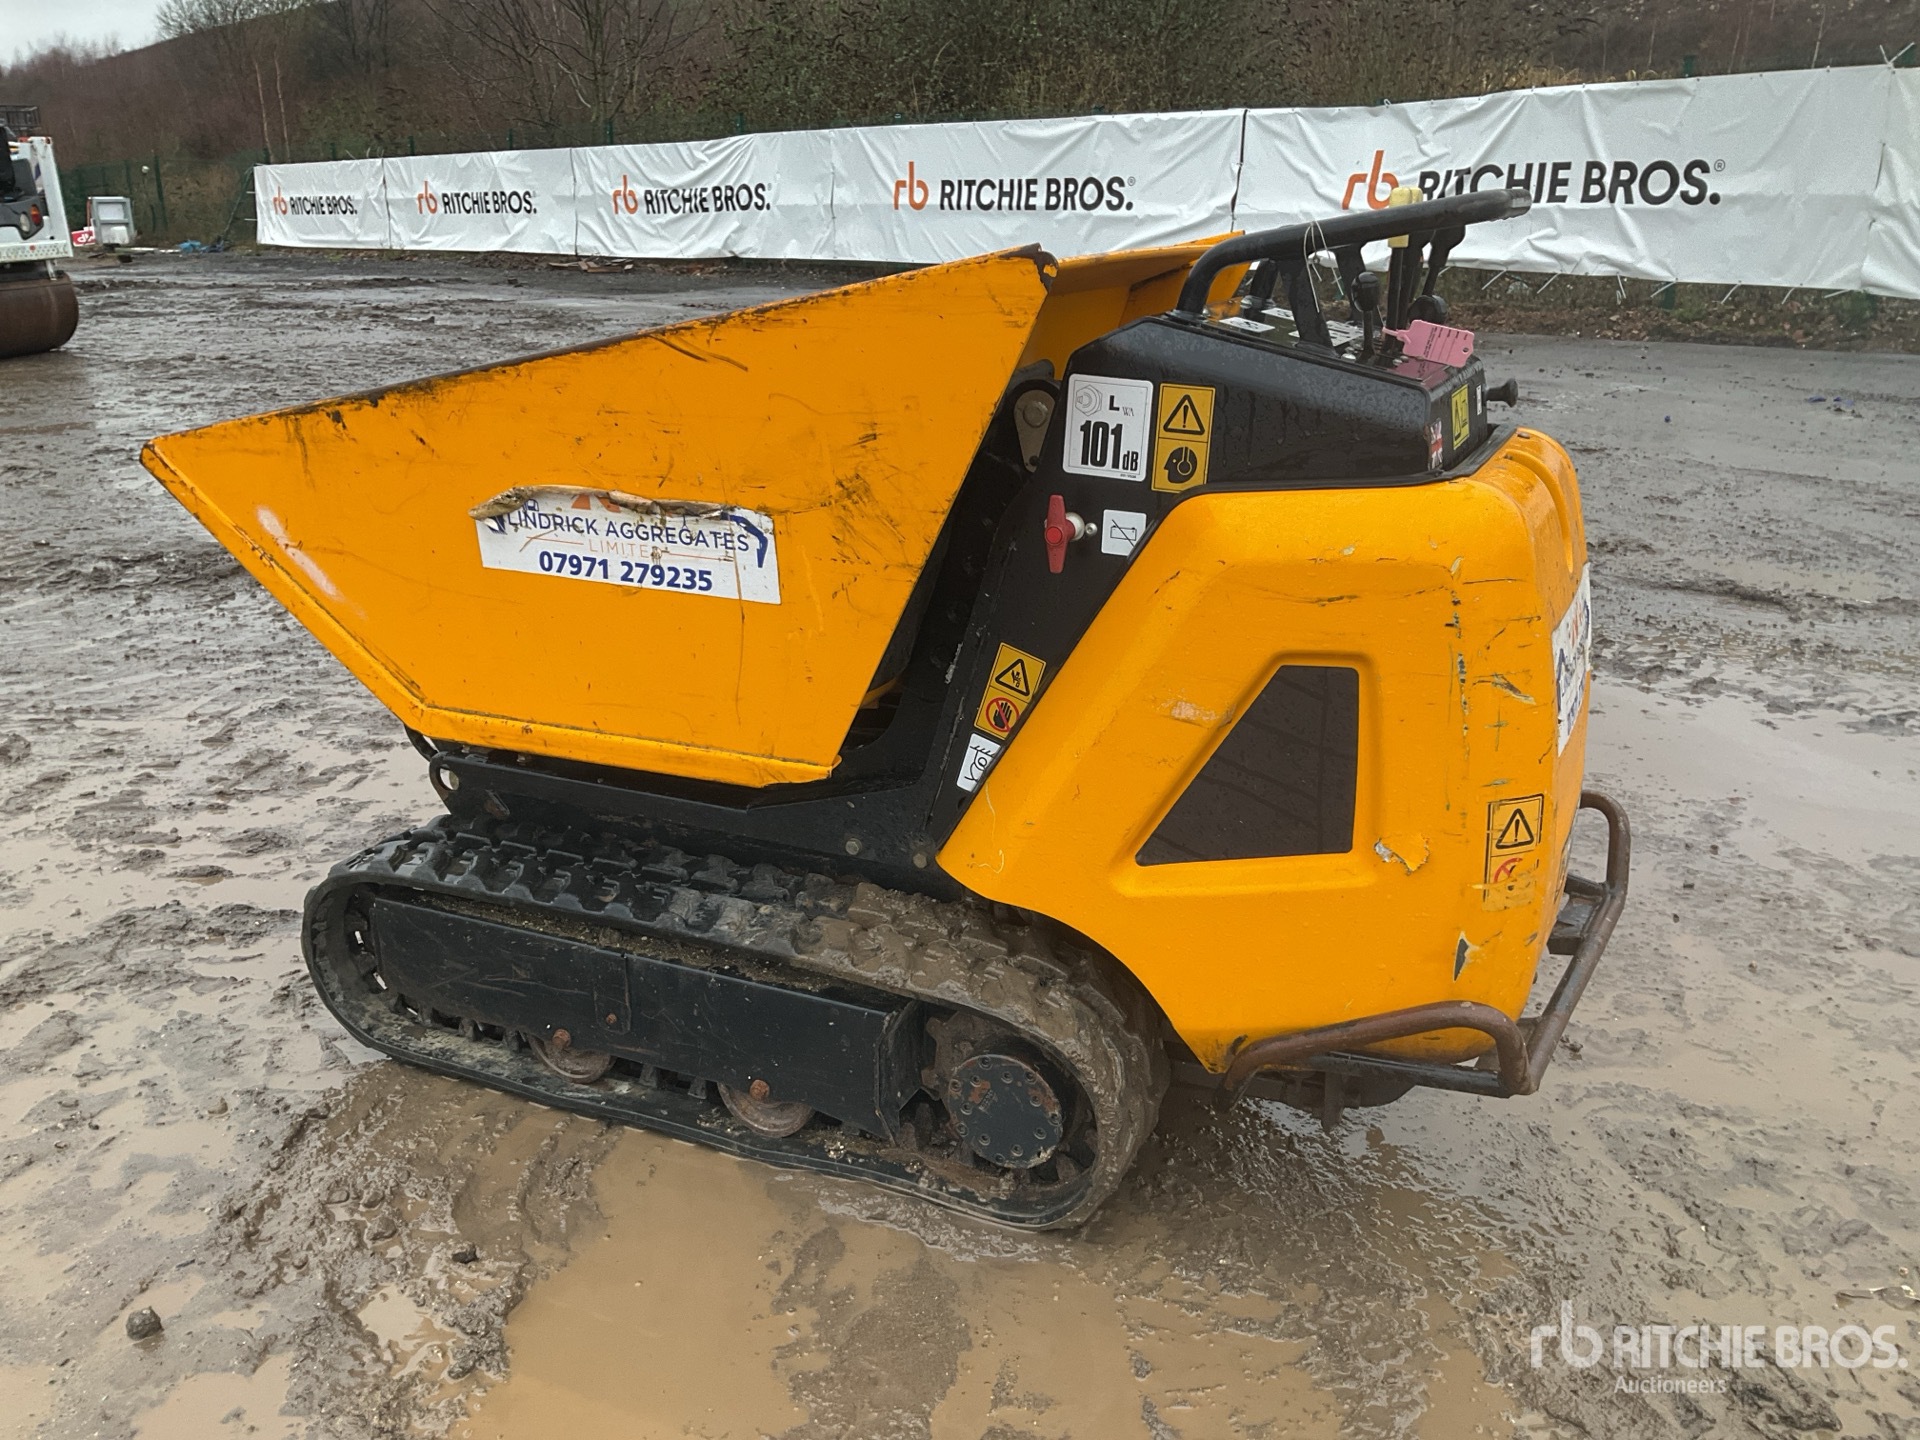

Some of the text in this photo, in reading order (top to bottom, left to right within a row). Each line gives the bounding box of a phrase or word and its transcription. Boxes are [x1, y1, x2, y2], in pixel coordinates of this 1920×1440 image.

[289, 196, 326, 215] RITCHIE
[325, 195, 358, 215] BROS.
[417, 180, 537, 214] rb RITCHIE BROS.
[612, 174, 771, 214] rb RITCHIE BROS.
[893, 160, 929, 211] rb
[939, 178, 1038, 211] RITCHIE
[1109, 395, 1120, 411] L
[1079, 420, 1139, 472] 101 dB
[507, 510, 749, 552] LINDRICK AGGREGATES
[588, 539, 661, 560] LIMITE
[539, 550, 713, 592] 07971 279235
